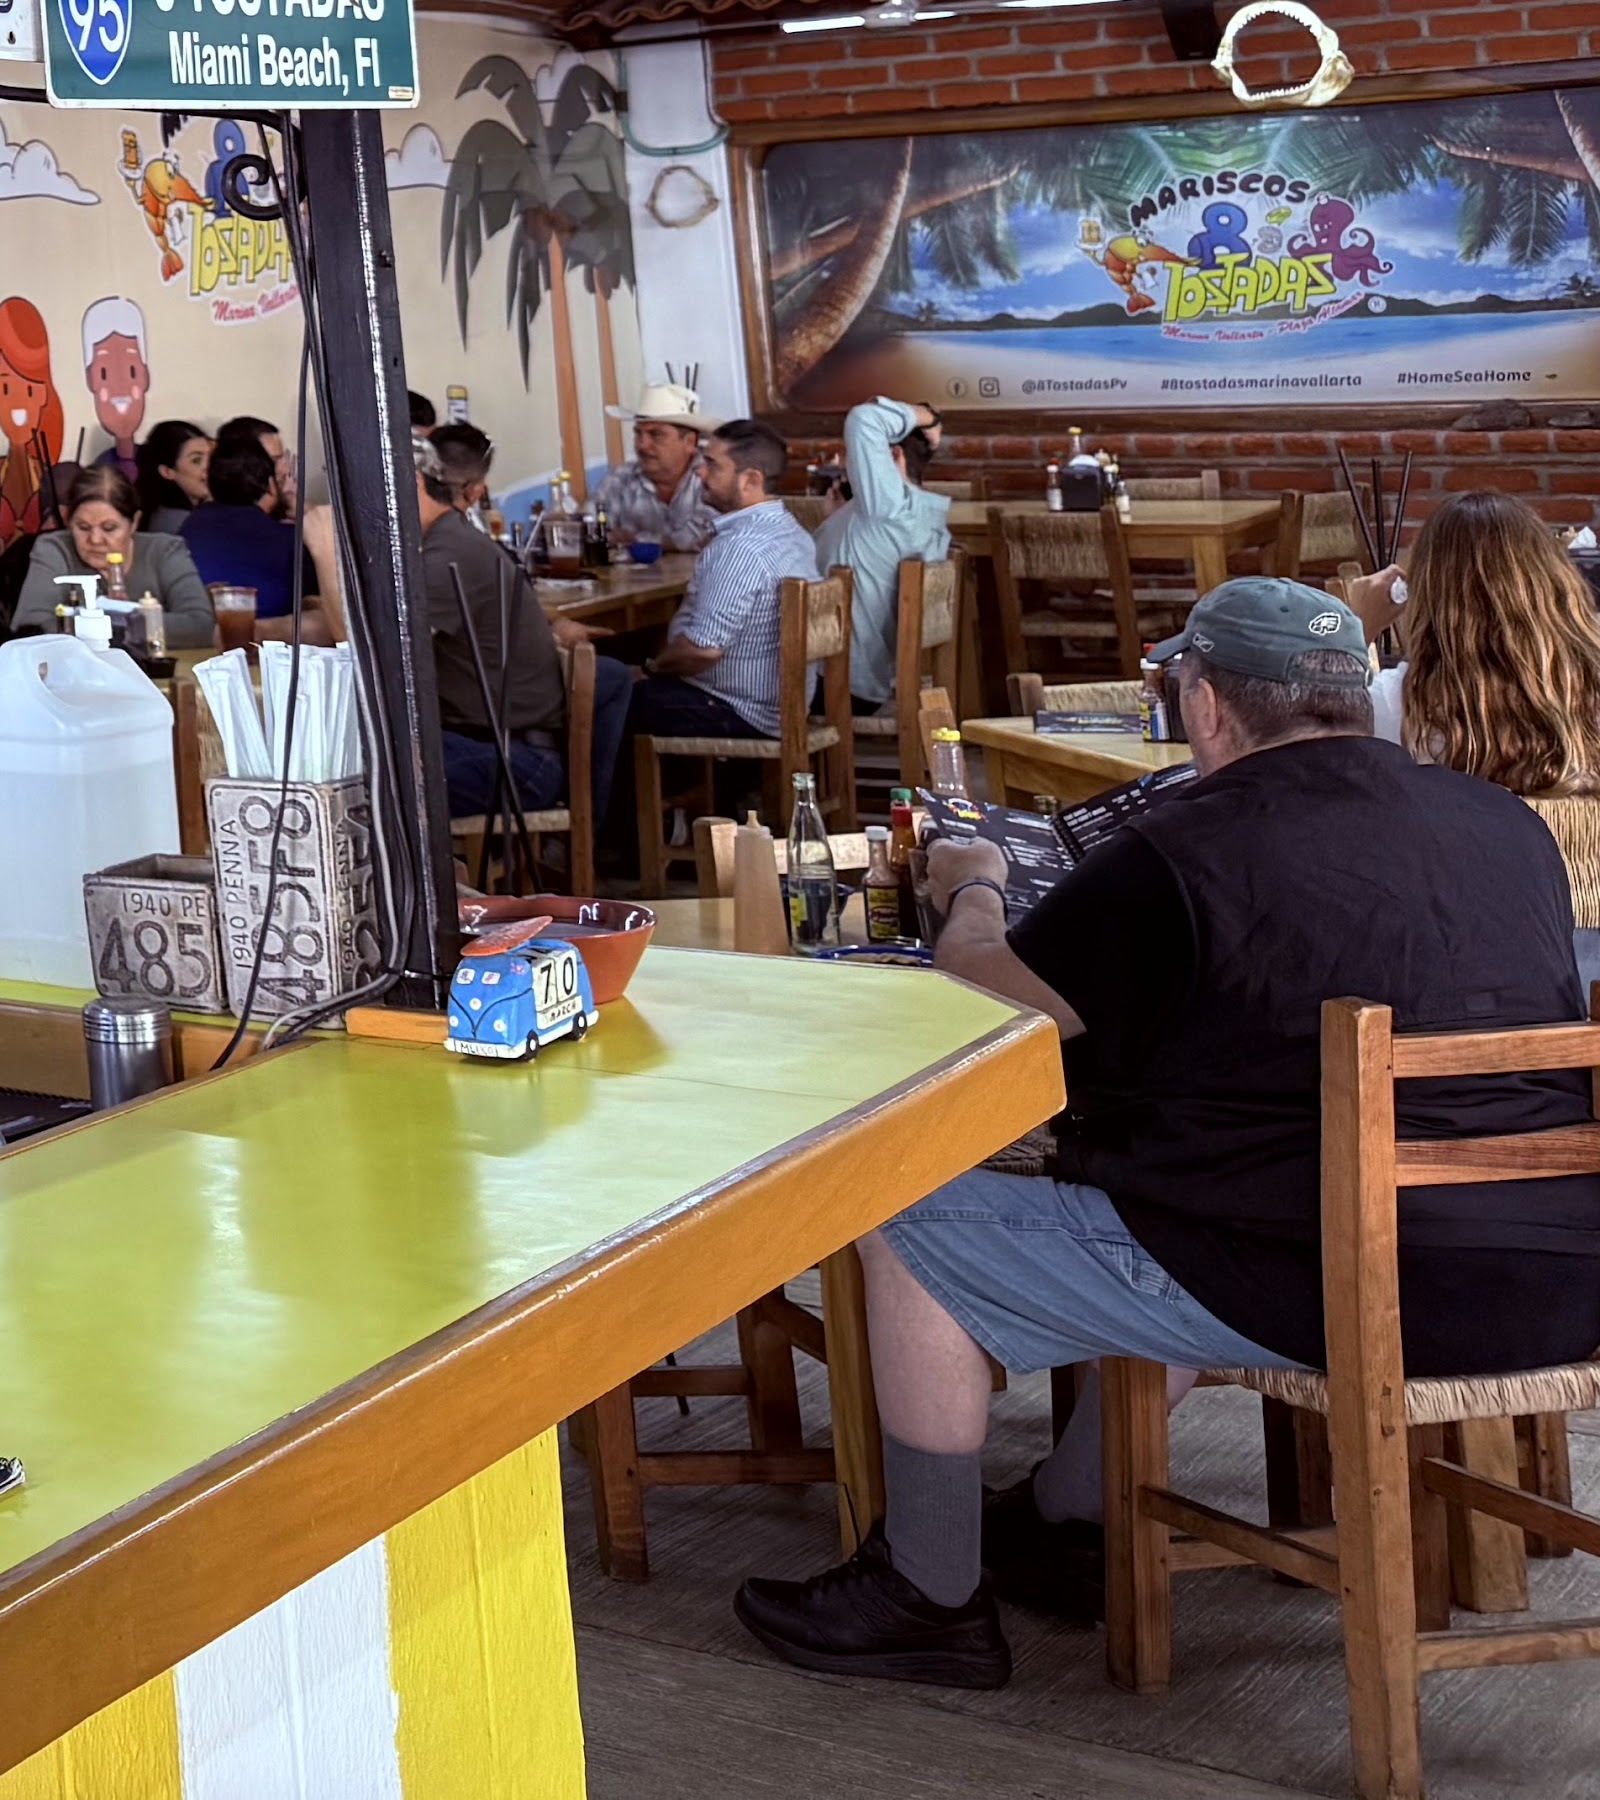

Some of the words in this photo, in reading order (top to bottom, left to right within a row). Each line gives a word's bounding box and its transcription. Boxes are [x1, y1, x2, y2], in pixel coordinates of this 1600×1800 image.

[170, 30, 250, 87] Miami
[257, 31, 349, 97] Beach,
[1131, 171, 1311, 228] MARISCOS
[1188, 201, 1252, 270] 8
[1163, 253, 1337, 323] TOSTADAS
[1161, 372, 1363, 392] #8tostadasmarinavallarta
[1397, 368, 1532, 388] #HomeSeaHome
[121, 891, 172, 917] 1940
[99, 916, 213, 998] 485
[539, 956, 574, 1005] 70
